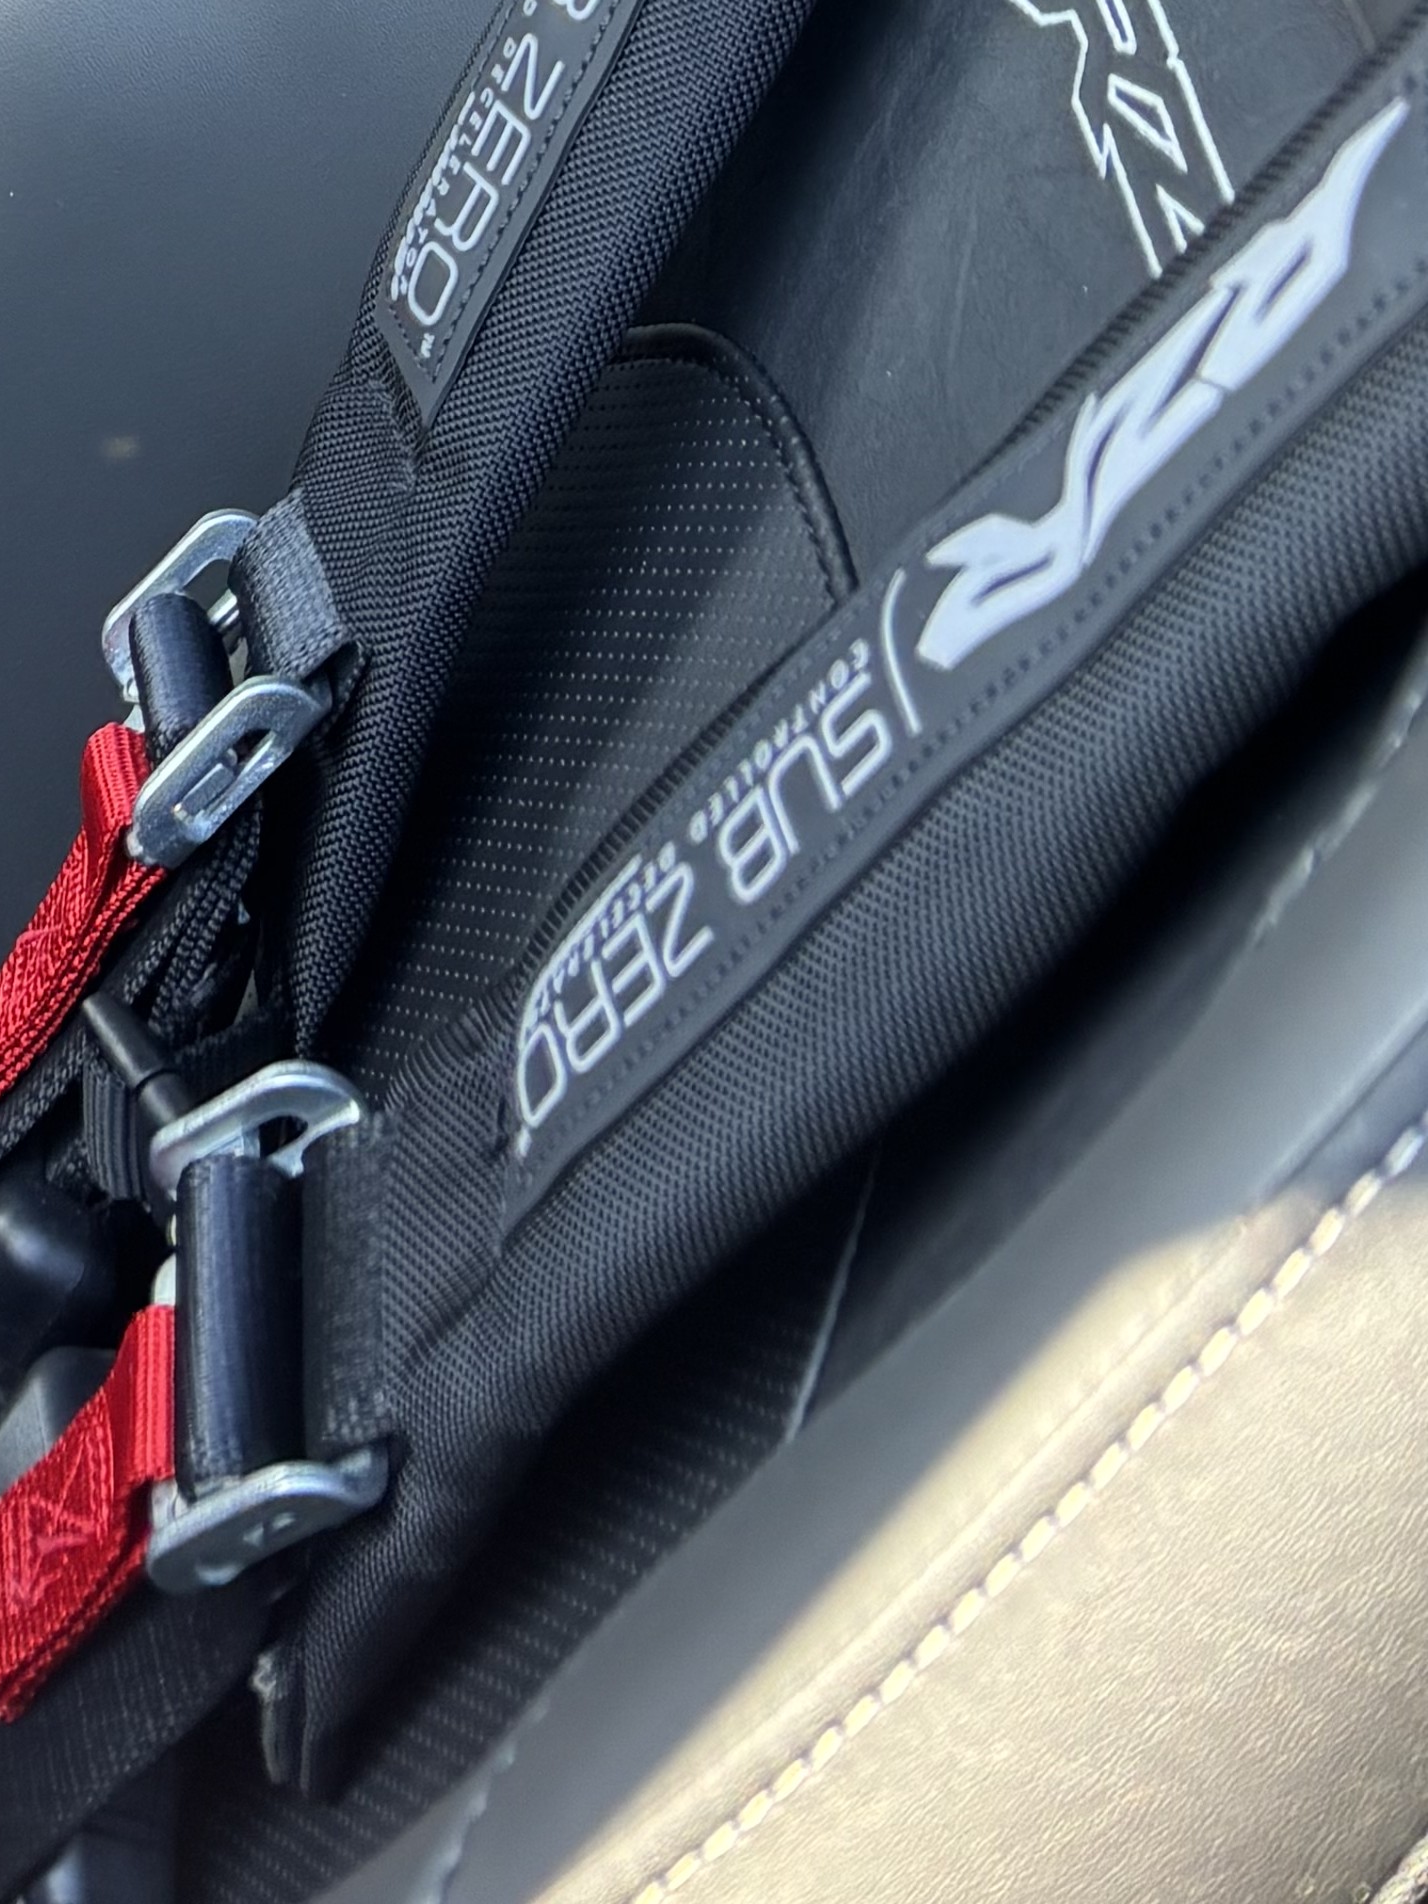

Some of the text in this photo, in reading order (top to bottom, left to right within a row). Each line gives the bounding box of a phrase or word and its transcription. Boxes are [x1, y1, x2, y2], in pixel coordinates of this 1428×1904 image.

[916, 96, 1411, 672] RZR
[688, 638, 871, 844] CONTROLLED
[716, 672, 892, 905] SUB
